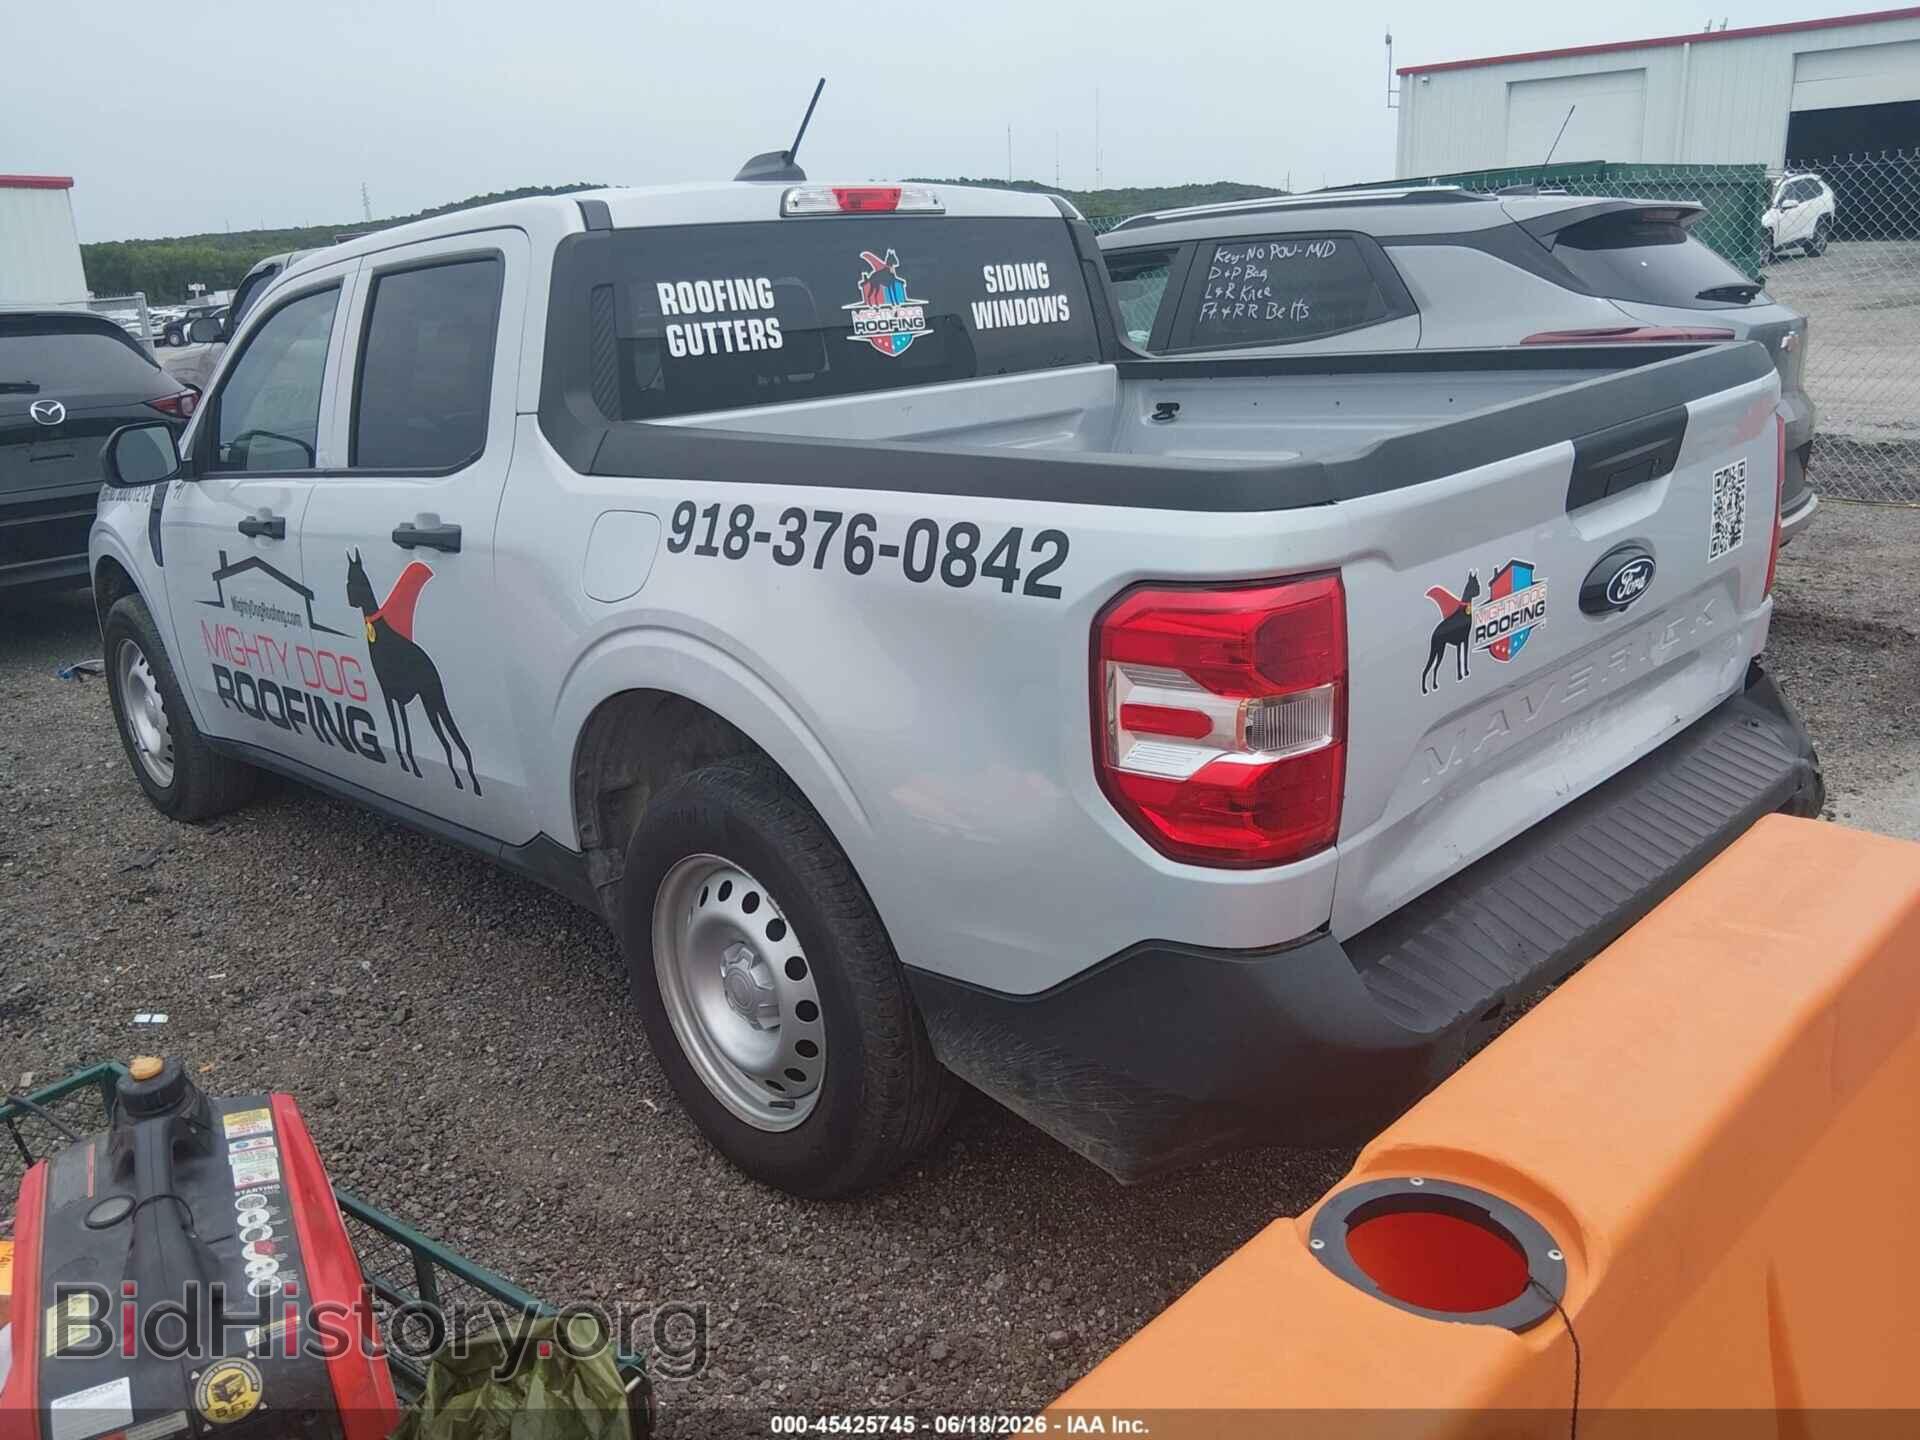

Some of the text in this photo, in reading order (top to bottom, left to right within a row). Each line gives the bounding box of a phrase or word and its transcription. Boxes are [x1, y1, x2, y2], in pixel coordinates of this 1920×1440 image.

[984, 262, 1050, 294] SIDING
[1244, 265, 1268, 282] Bag
[656, 277, 775, 316] ROOFING
[1239, 284, 1272, 302] Knee
[1265, 298, 1310, 322] Belts
[855, 317, 924, 332] ROOFING
[971, 295, 1070, 330] WINDOWS
[665, 317, 783, 358] GUTTERS
[667, 500, 1070, 600] 918-376-0842
[1616, 564, 1649, 600] Ford
[1475, 600, 1545, 643] ROOFING
[201, 619, 368, 702] MIGHTY DOG
[1421, 598, 1716, 785] MAVERICK
[212, 663, 387, 764] ROOFING
